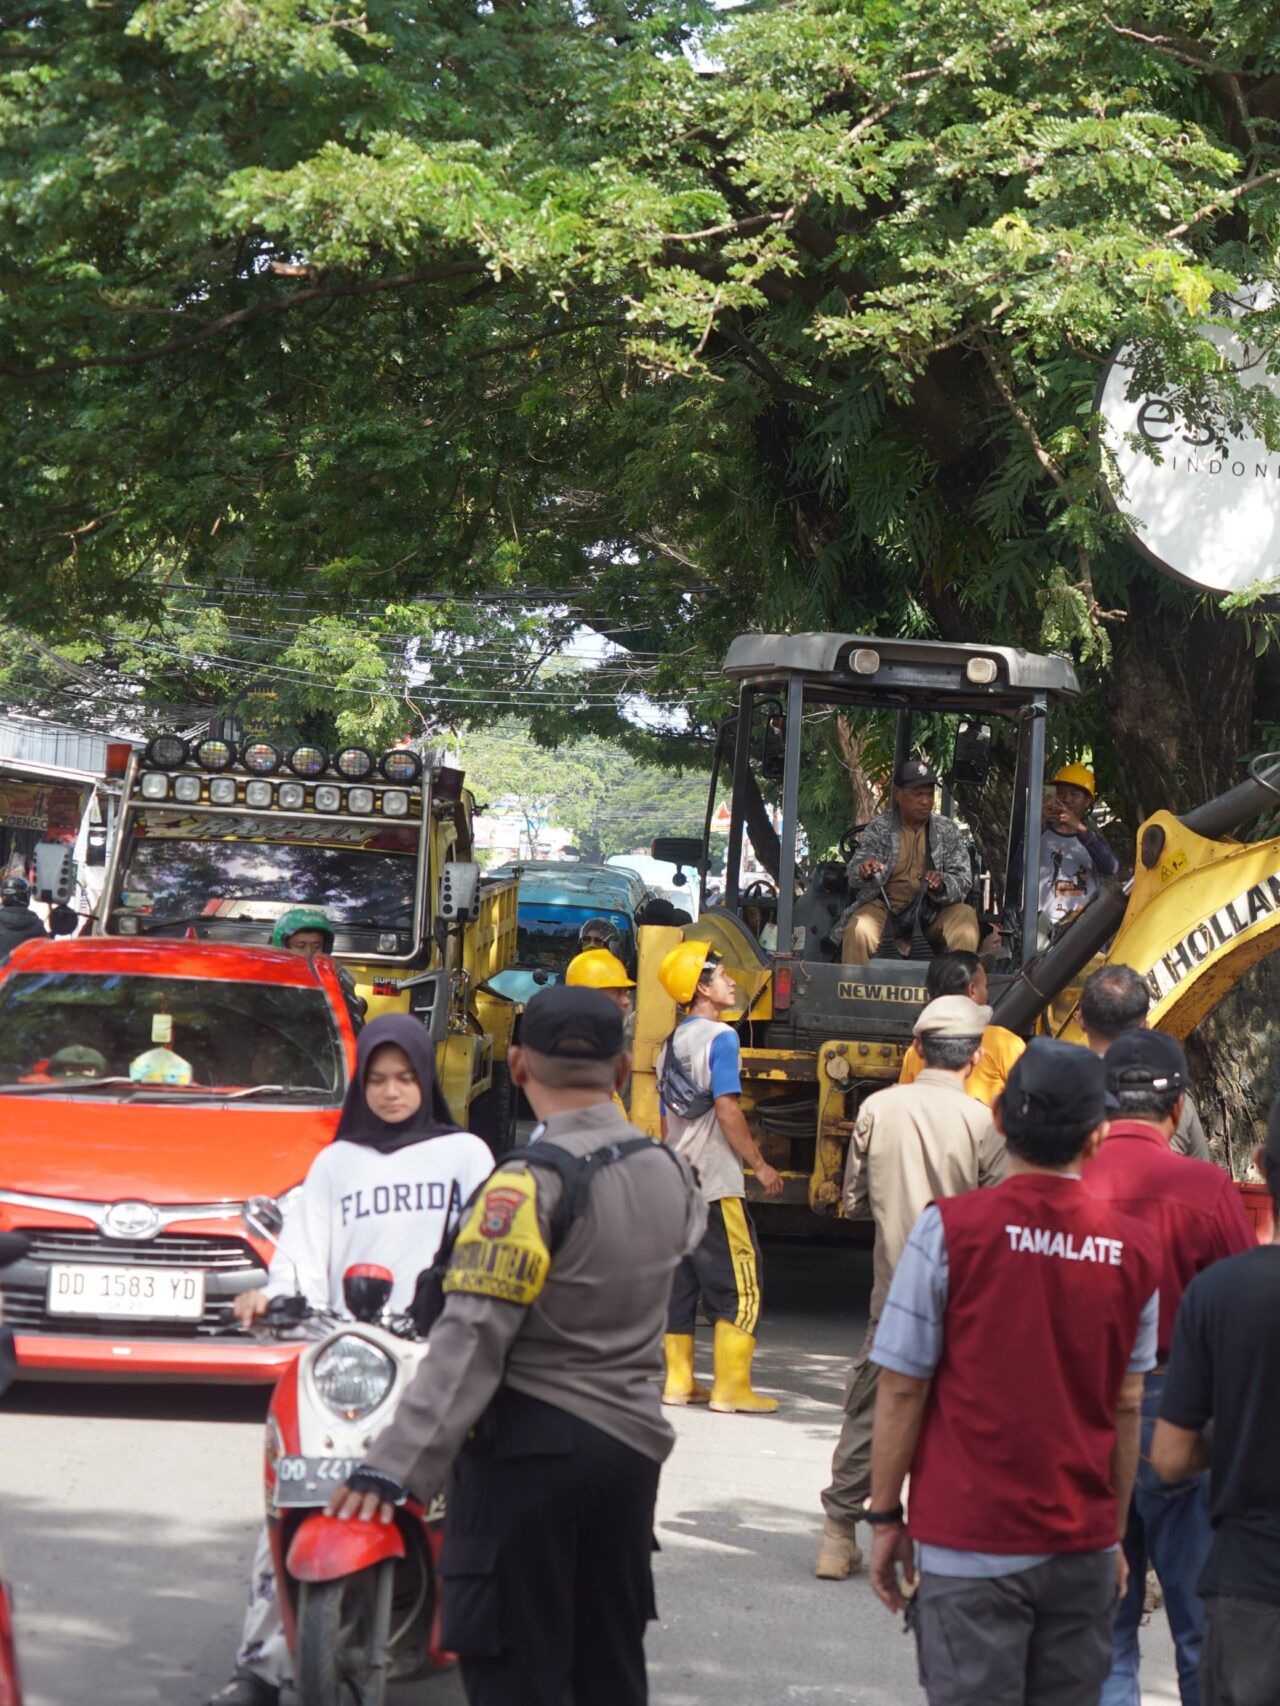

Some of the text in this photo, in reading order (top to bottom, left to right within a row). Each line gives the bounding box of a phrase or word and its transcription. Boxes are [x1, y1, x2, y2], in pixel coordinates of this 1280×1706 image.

[840, 983, 928, 1002] NEW HOLL
[340, 1179, 463, 1227] FLORIDA
[1005, 1225, 1124, 1266] TAMALATE
[58, 1273, 196, 1300] DD 1583 YD
